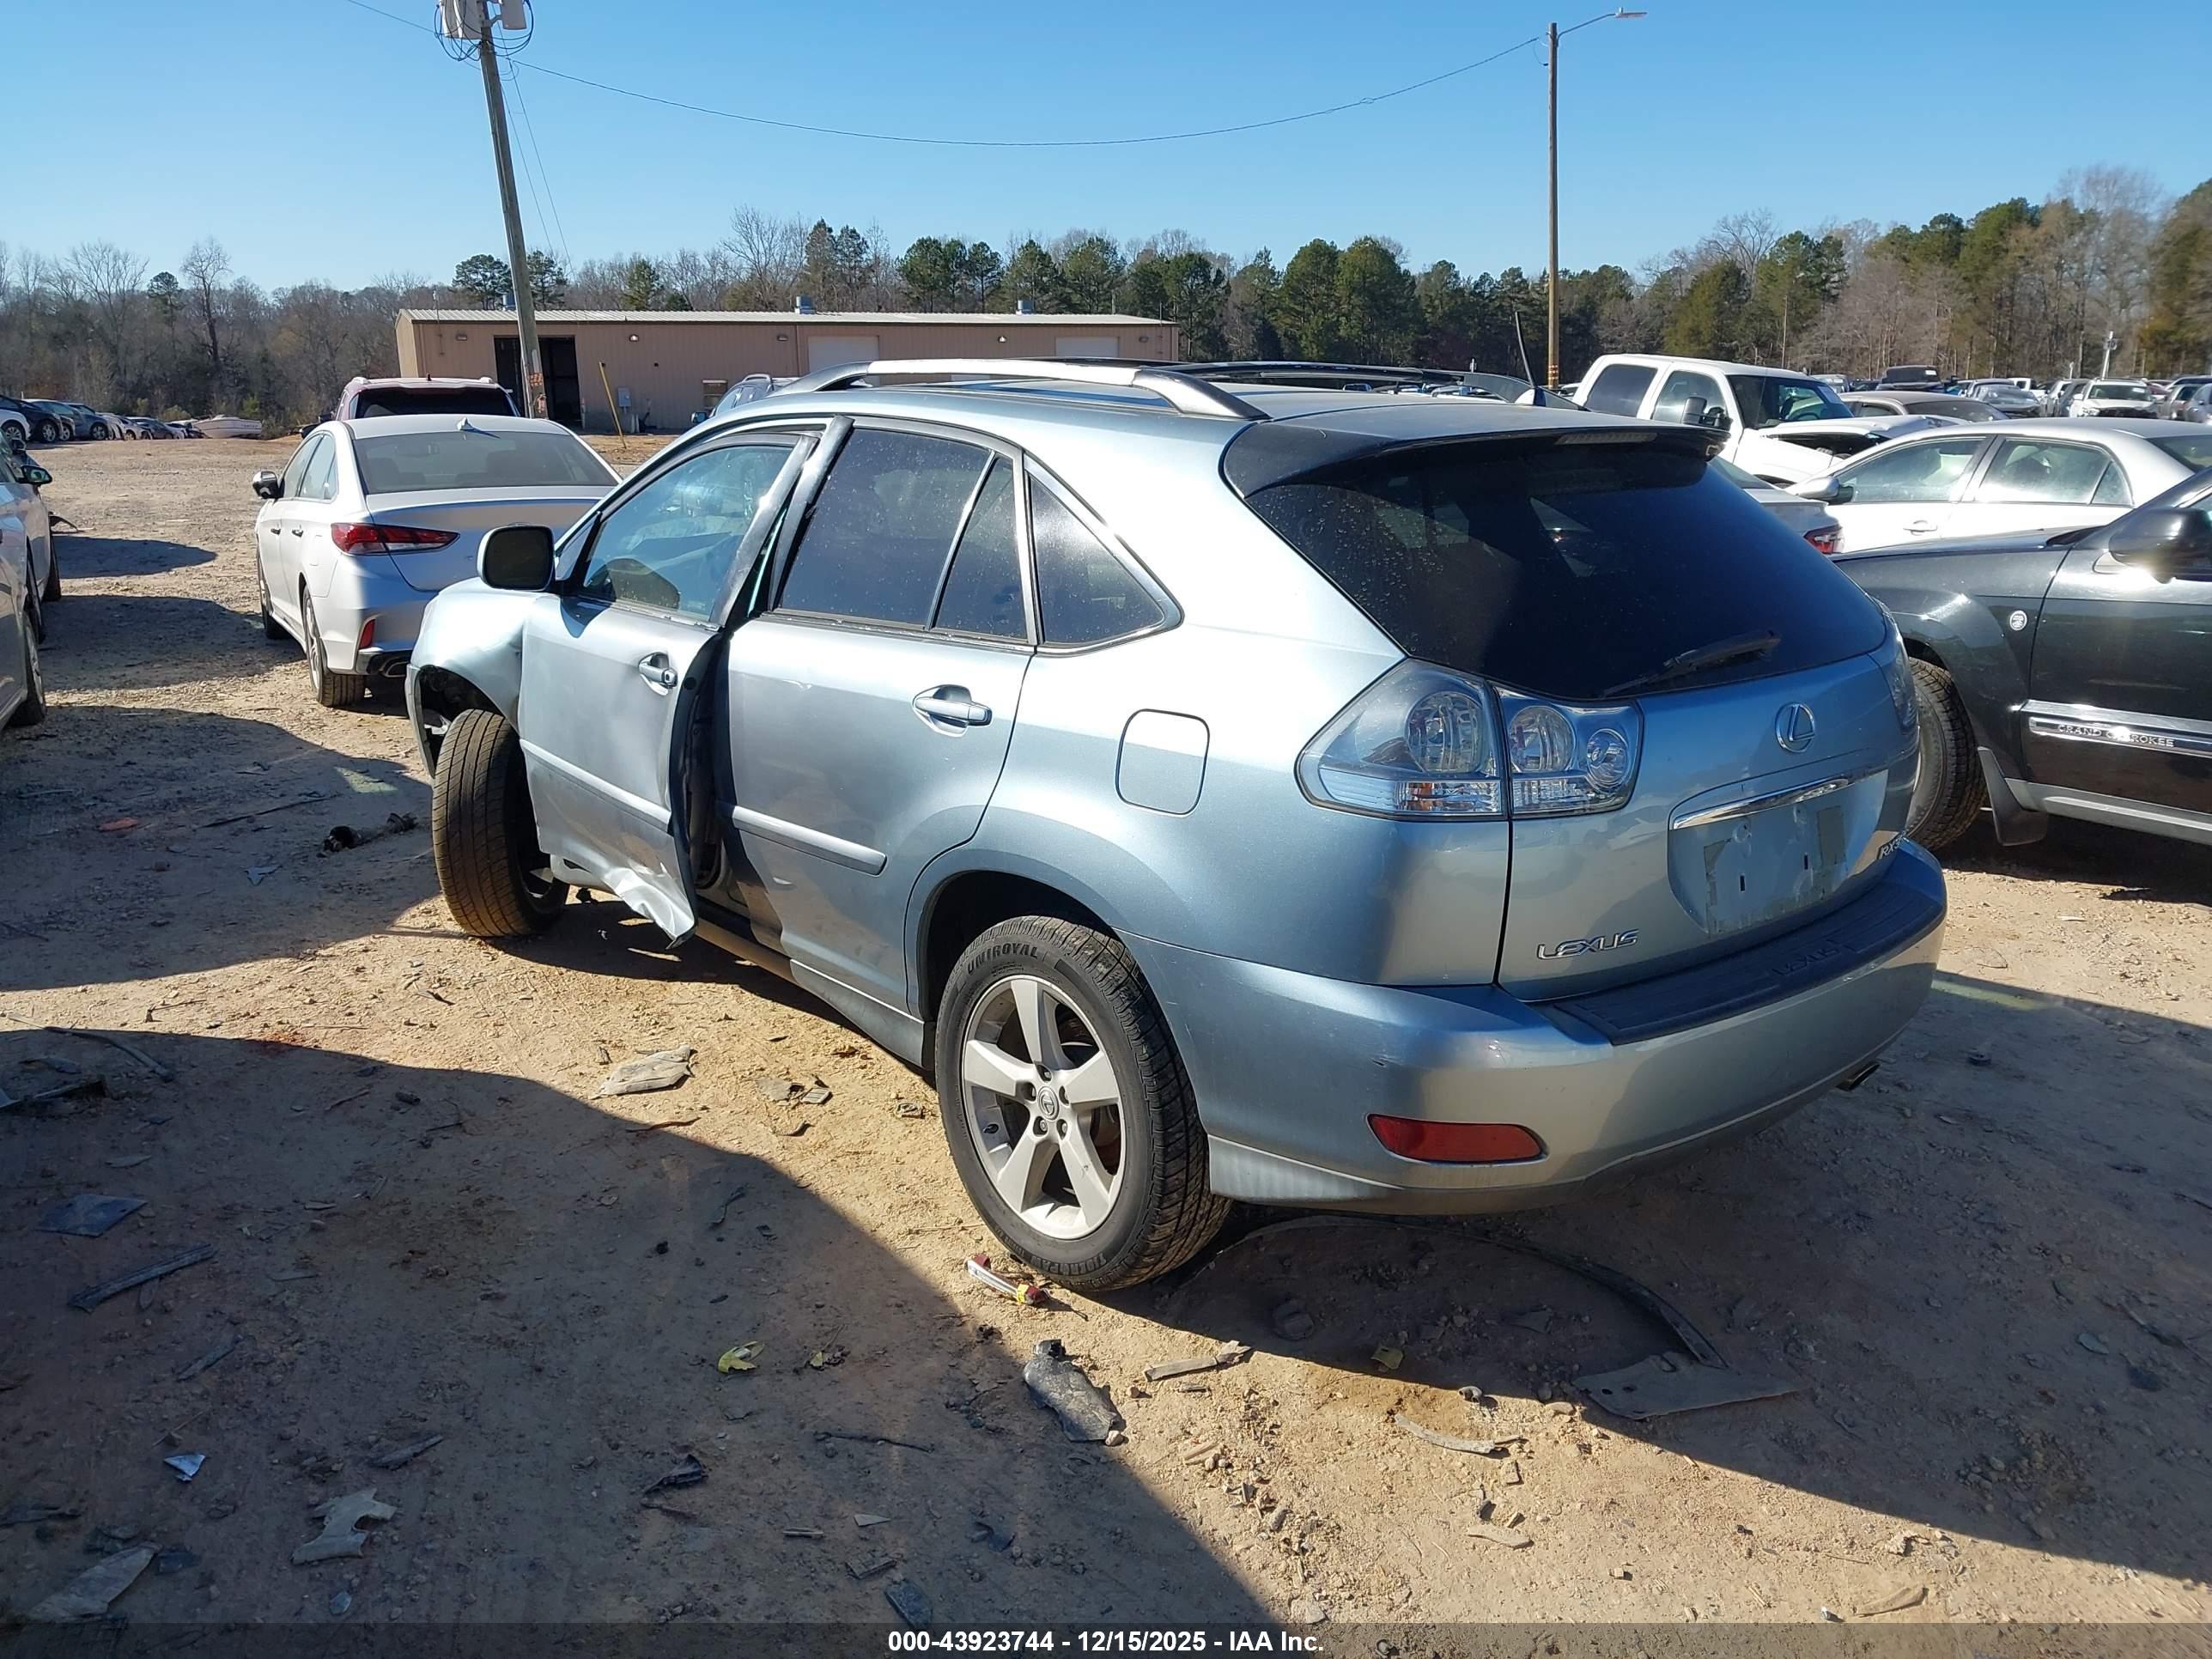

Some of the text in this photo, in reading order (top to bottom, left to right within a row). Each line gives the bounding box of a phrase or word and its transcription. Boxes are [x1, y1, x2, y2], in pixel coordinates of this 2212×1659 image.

[2057, 724, 2174, 747] GRAND CROKEE
[967, 943, 1038, 975] UNIROYAL
[1537, 928, 1639, 960] LEXUS
